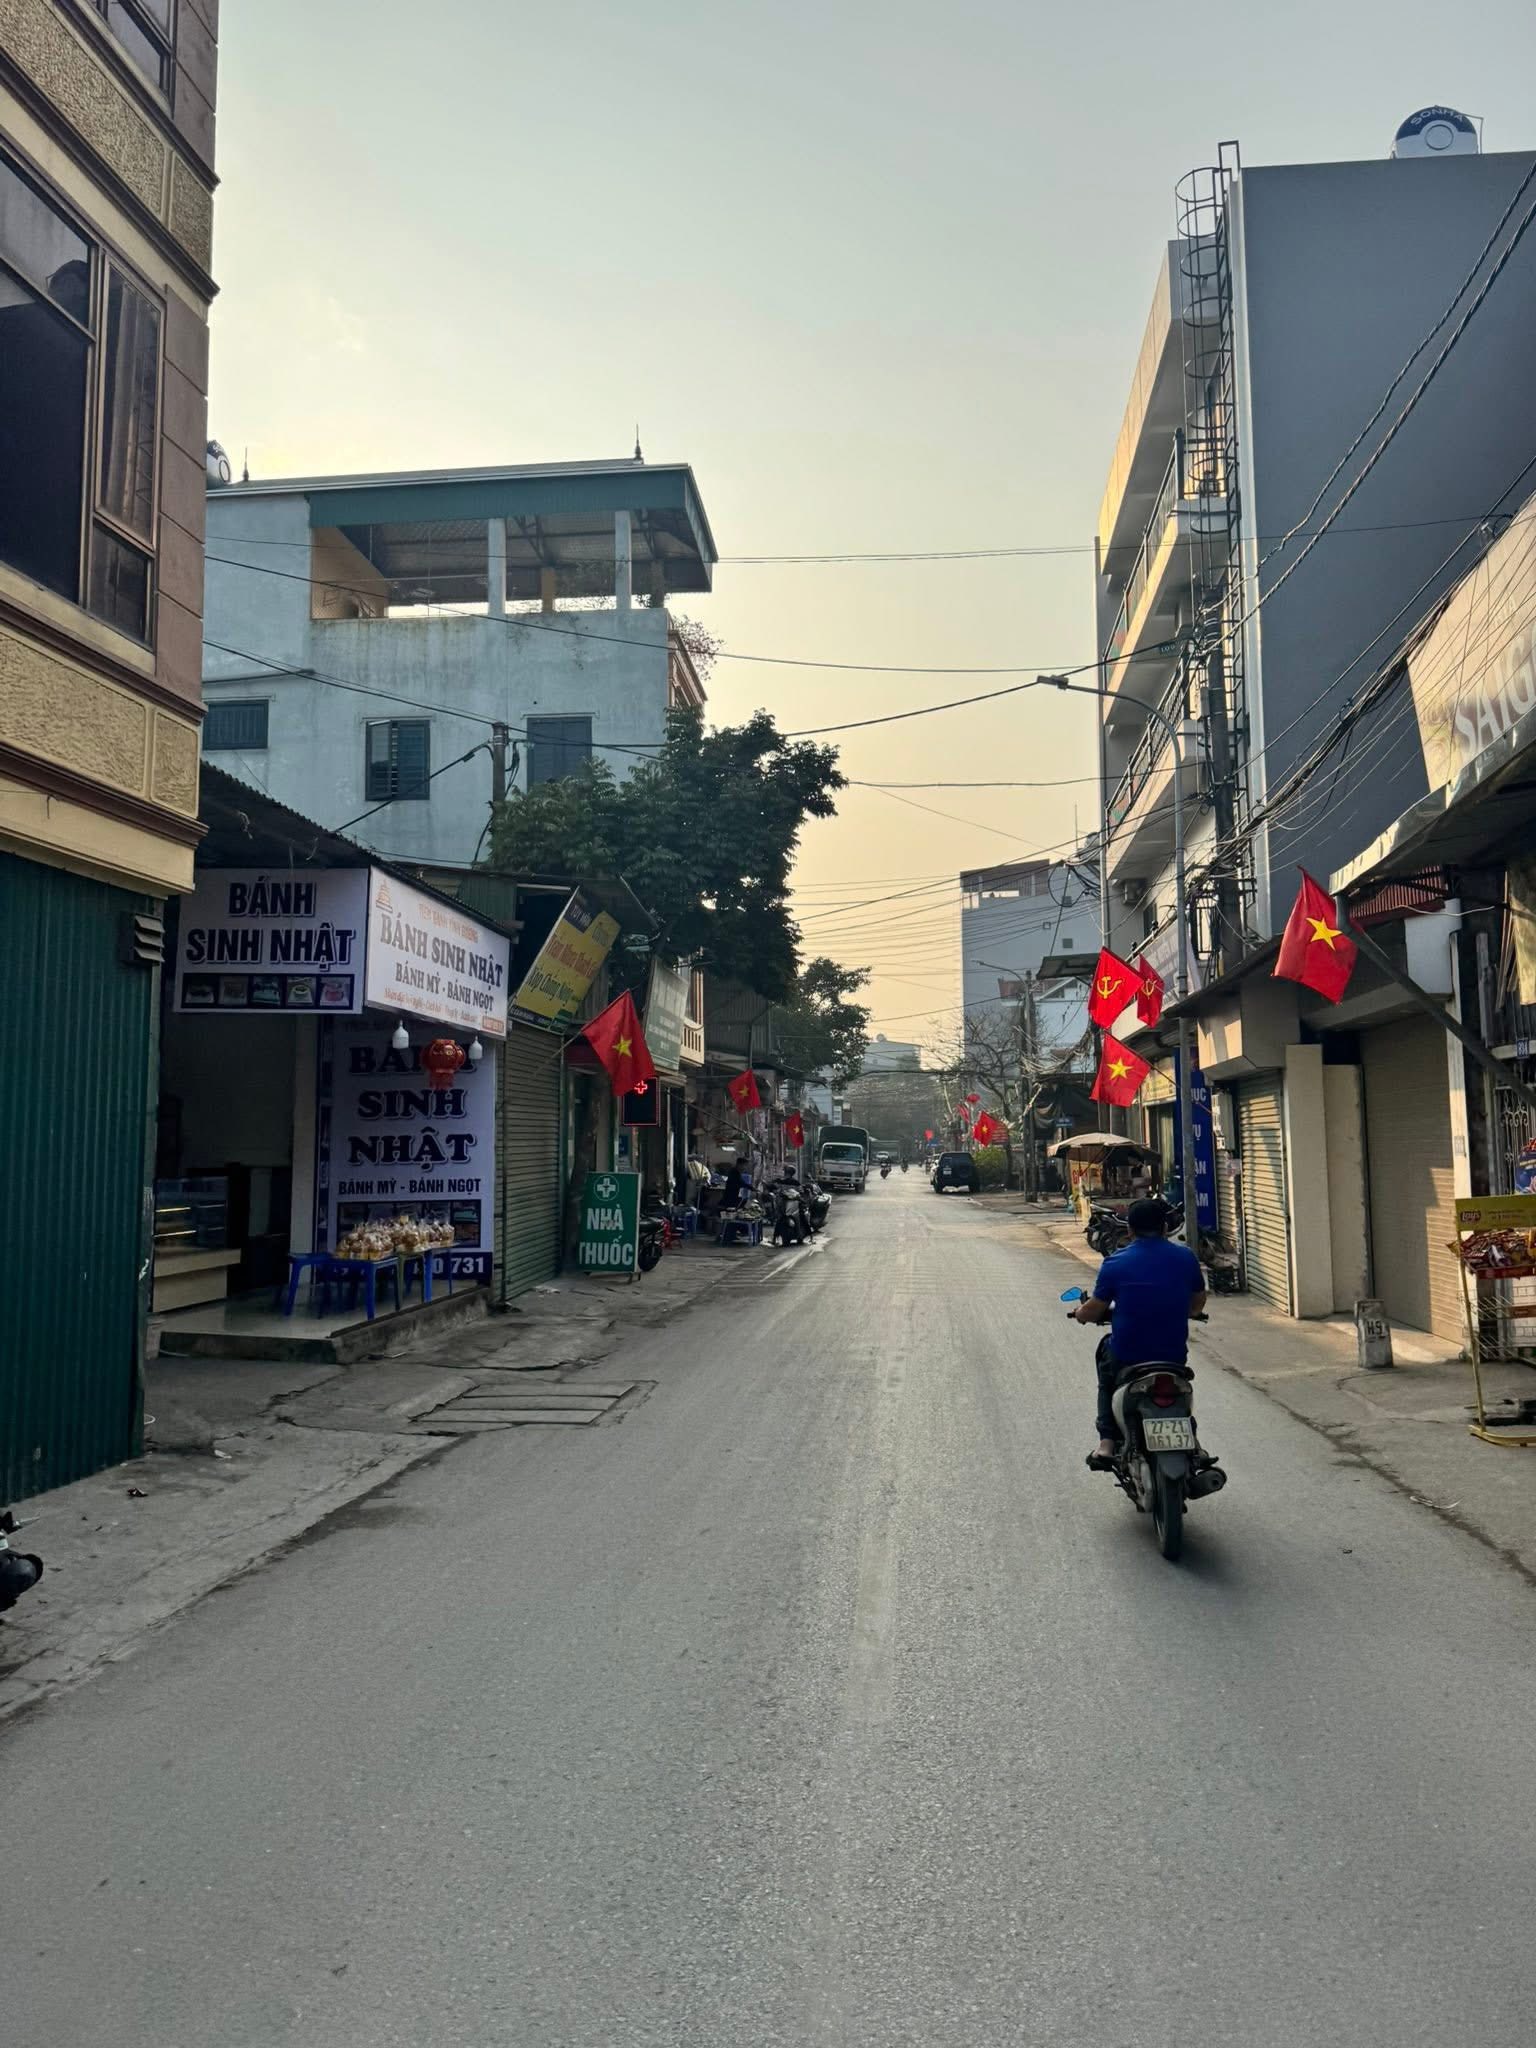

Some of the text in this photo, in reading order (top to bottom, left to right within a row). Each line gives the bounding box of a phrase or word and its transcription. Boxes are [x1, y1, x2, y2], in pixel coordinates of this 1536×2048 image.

[1455, 624, 1536, 758] SAIG
[229, 875, 316, 918] BÁNH
[186, 922, 357, 972] SINH NHẬT
[380, 911, 429, 960] BÁNH
[431, 936, 466, 974] SINH
[469, 953, 503, 991] NHẬT
[395, 960, 425, 989] BÁNH
[447, 979, 472, 1005] BÁNH
[473, 991, 494, 1014] NGỌT
[358, 1088, 467, 1120] SINH
[348, 1126, 478, 1173] NHẬT
[339, 1179, 374, 1195] BÁNH
[409, 1177, 444, 1194] BÁNH
[447, 1178, 481, 1197] NGỌT
[586, 1203, 624, 1231] NHÀ
[451, 1257, 485, 1274] 731
[579, 1235, 633, 1266] THUỐC
